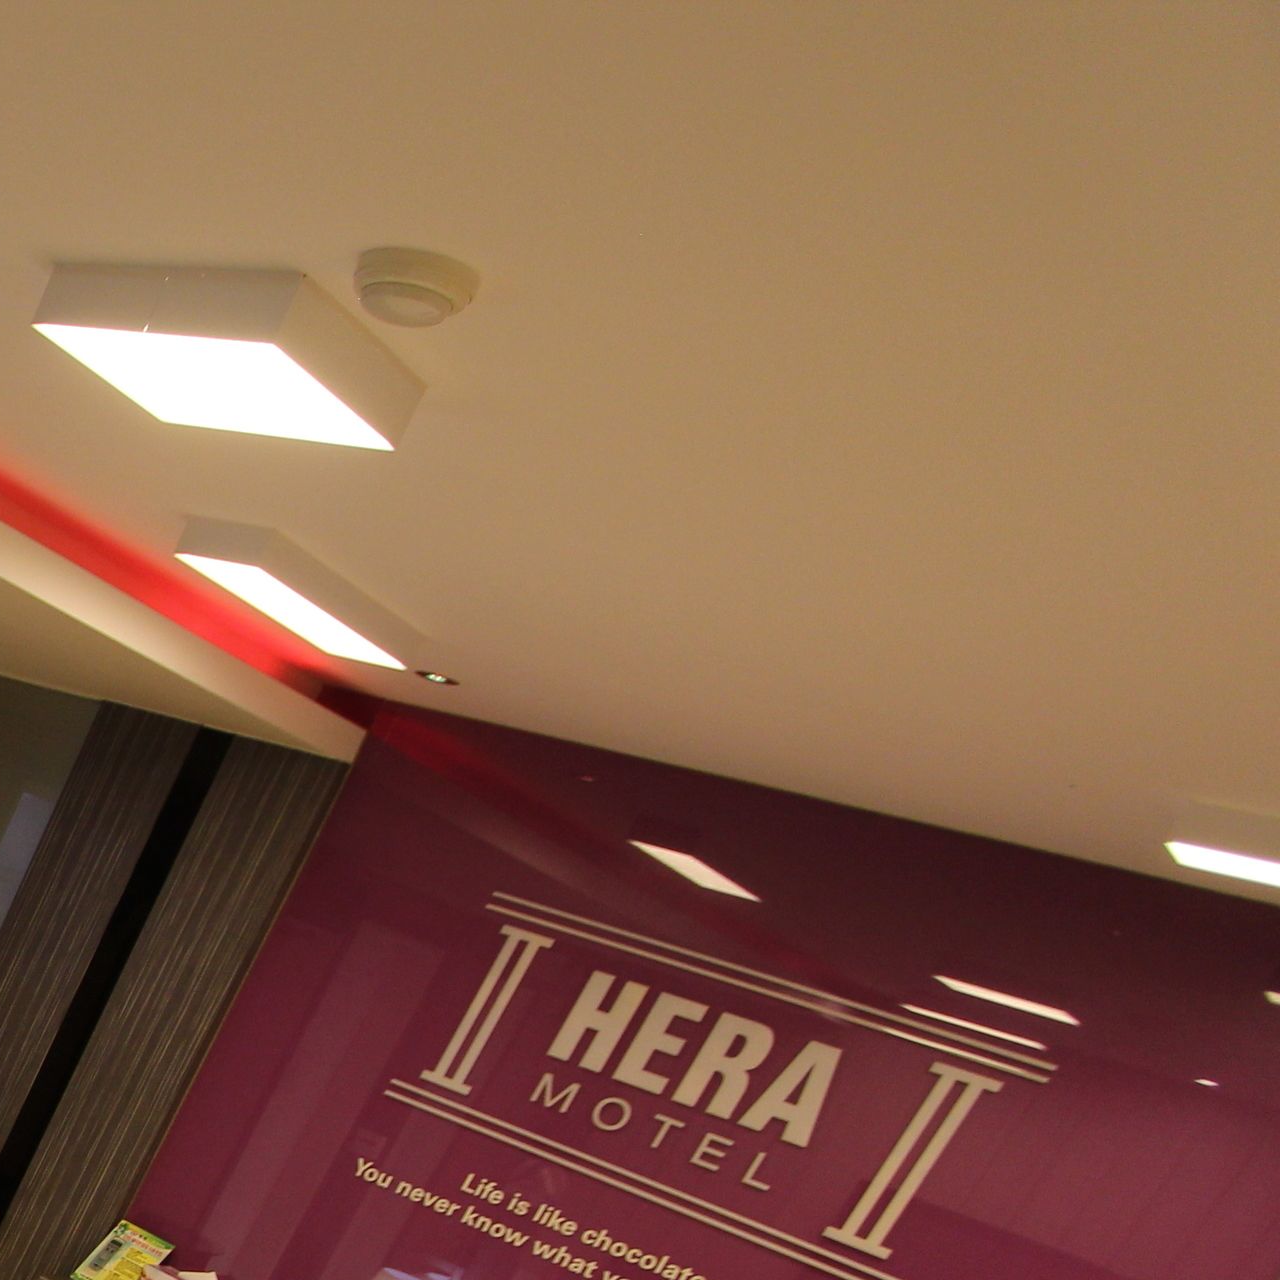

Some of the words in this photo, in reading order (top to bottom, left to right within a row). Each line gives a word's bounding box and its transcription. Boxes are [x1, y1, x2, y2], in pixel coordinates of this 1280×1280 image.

[546, 970, 843, 1147] HERA
[529, 1072, 771, 1191] MOTEL
[354, 1158, 394, 1188] You
[394, 1181, 461, 1216] never
[460, 1206, 530, 1247] know
[532, 1240, 599, 1279] what
[460, 1173, 505, 1204] Life
[506, 1193, 531, 1216] is
[532, 1204, 578, 1236] like
